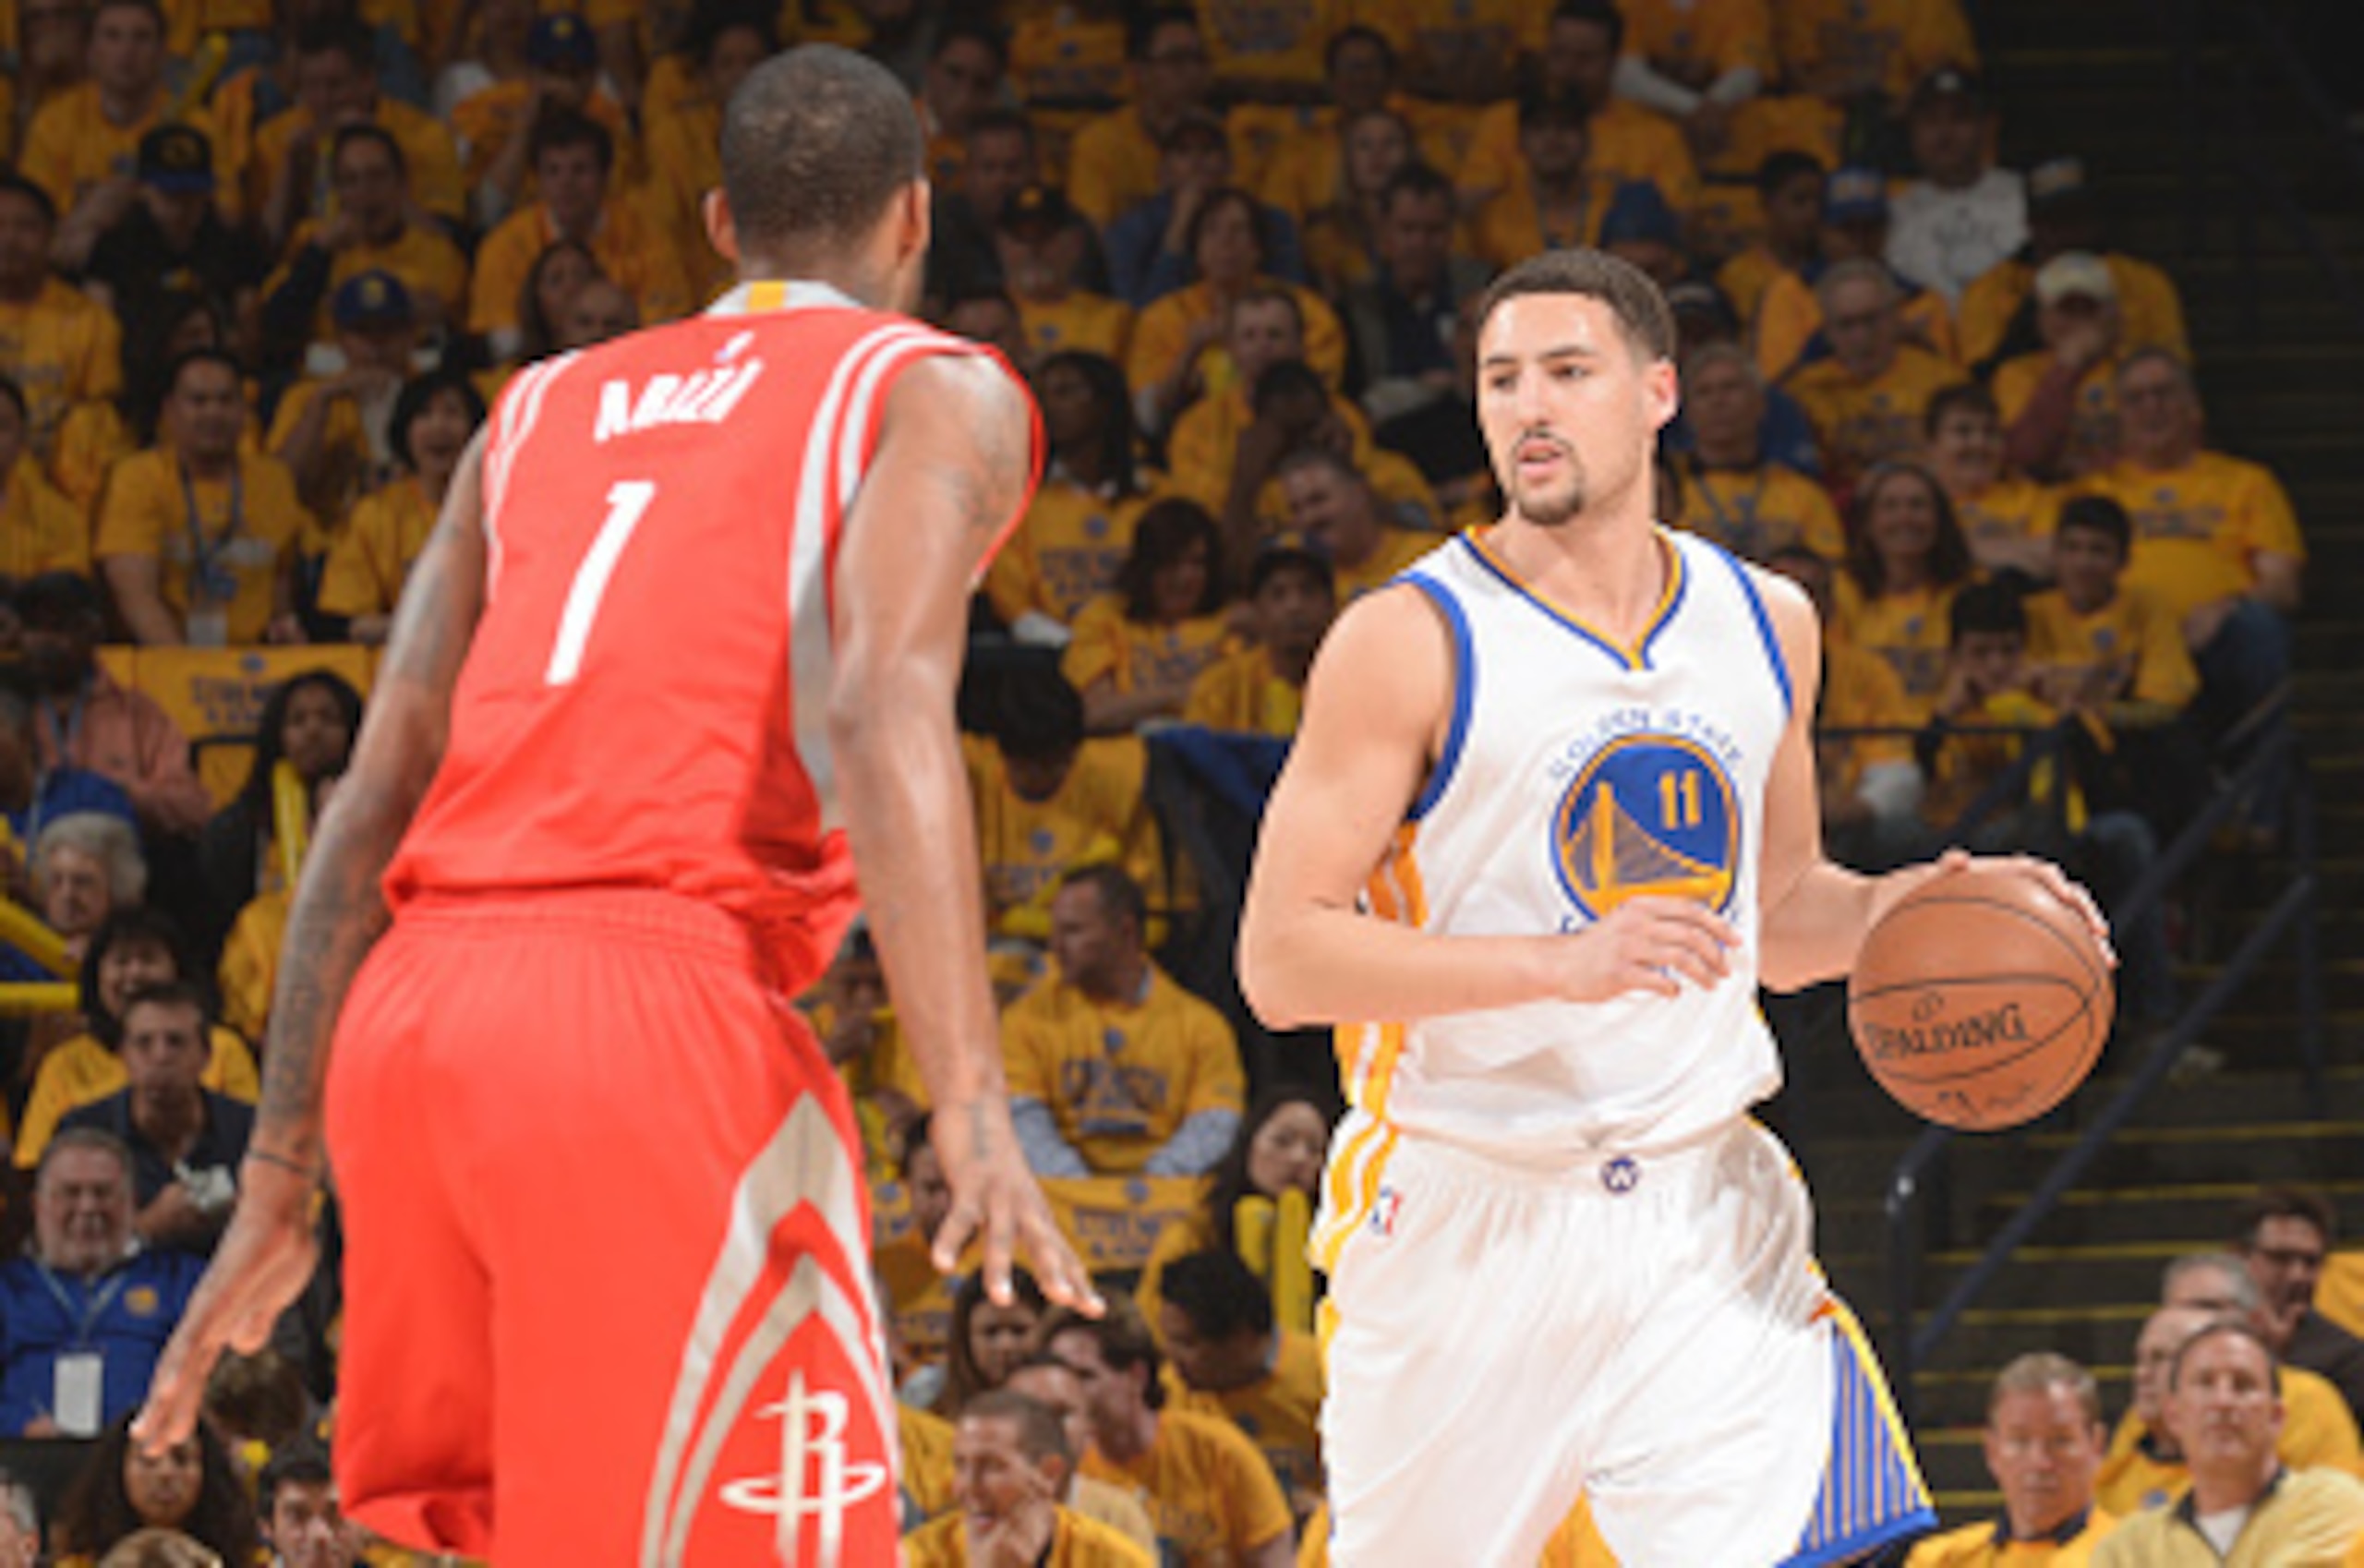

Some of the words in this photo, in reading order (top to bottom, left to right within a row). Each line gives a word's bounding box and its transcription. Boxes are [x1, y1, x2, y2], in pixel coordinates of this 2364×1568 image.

[544, 479, 656, 686] 1
[1659, 769, 1702, 829] 11
[1864, 1003, 2029, 1059] SPALDING
